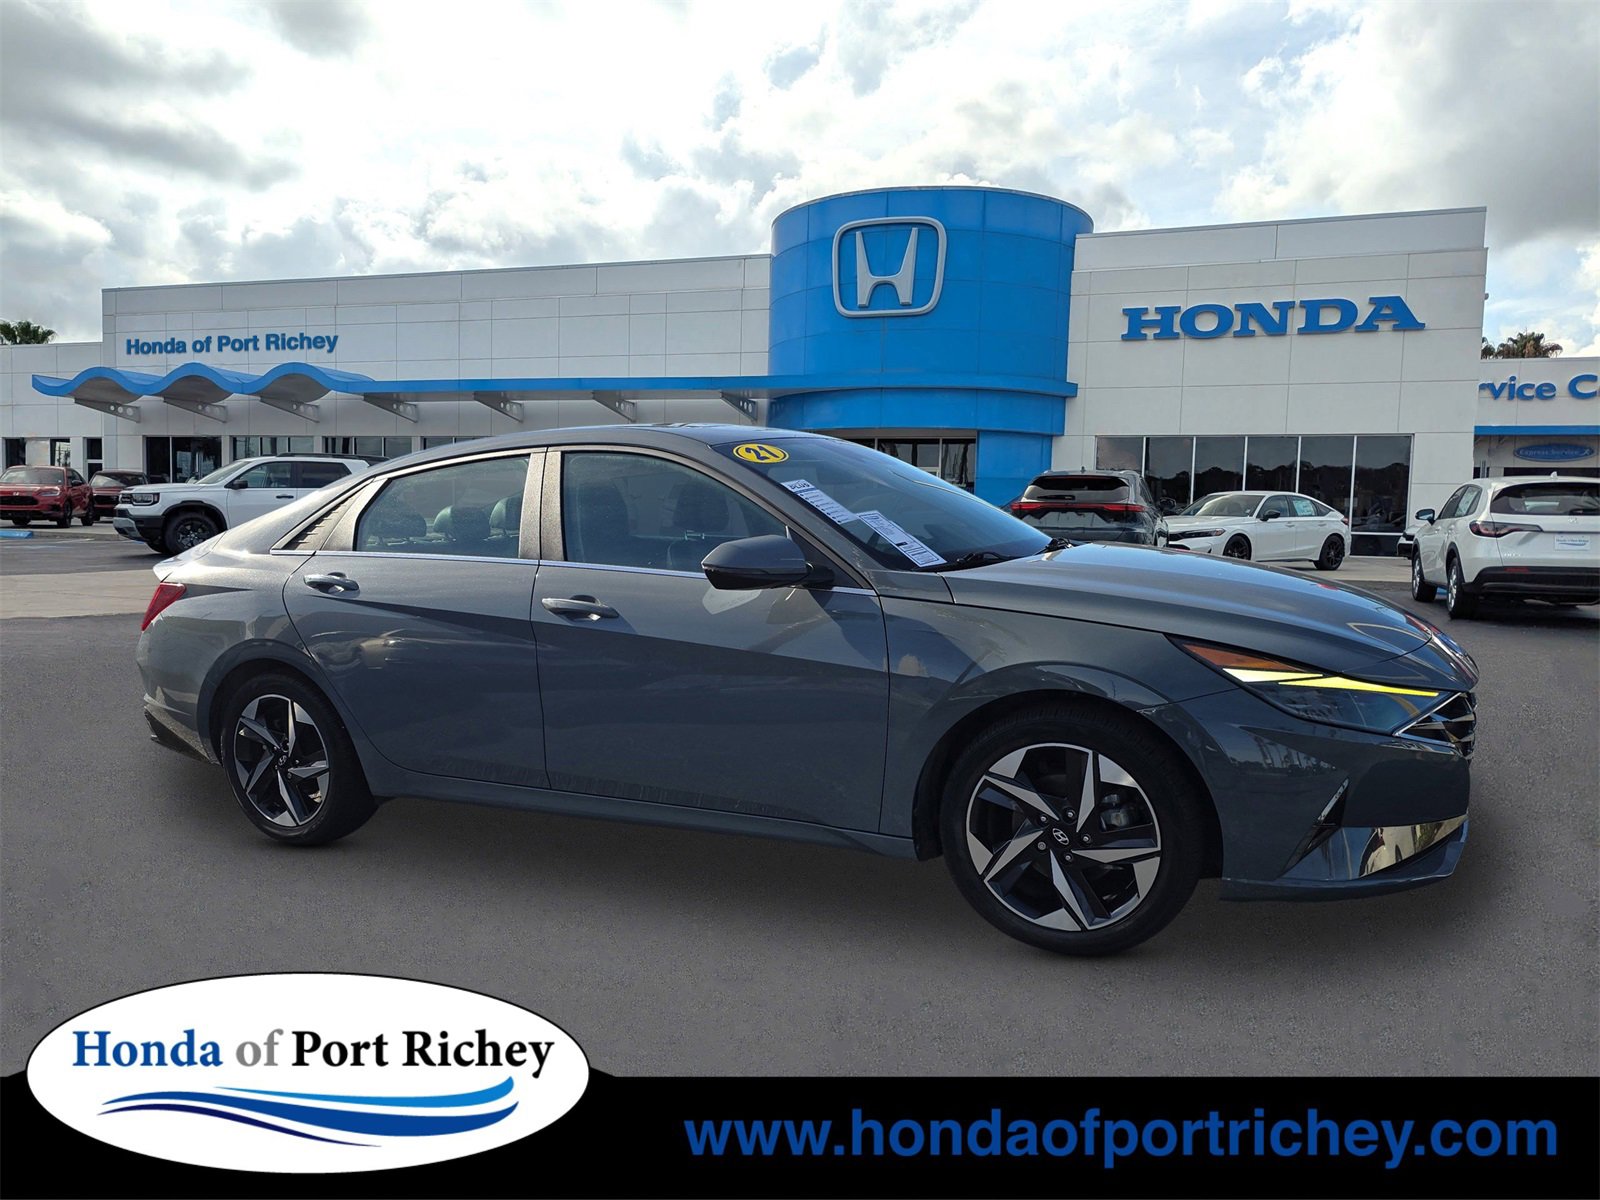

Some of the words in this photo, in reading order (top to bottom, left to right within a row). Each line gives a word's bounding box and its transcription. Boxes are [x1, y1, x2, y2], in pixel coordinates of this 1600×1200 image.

[1120, 295, 1426, 341] HONDA
[125, 337, 187, 355] Honda
[191, 335, 212, 353] of
[217, 335, 260, 352] Port
[265, 332, 339, 353] Richey
[1567, 373, 1600, 400] C
[744, 445, 780, 461] 21
